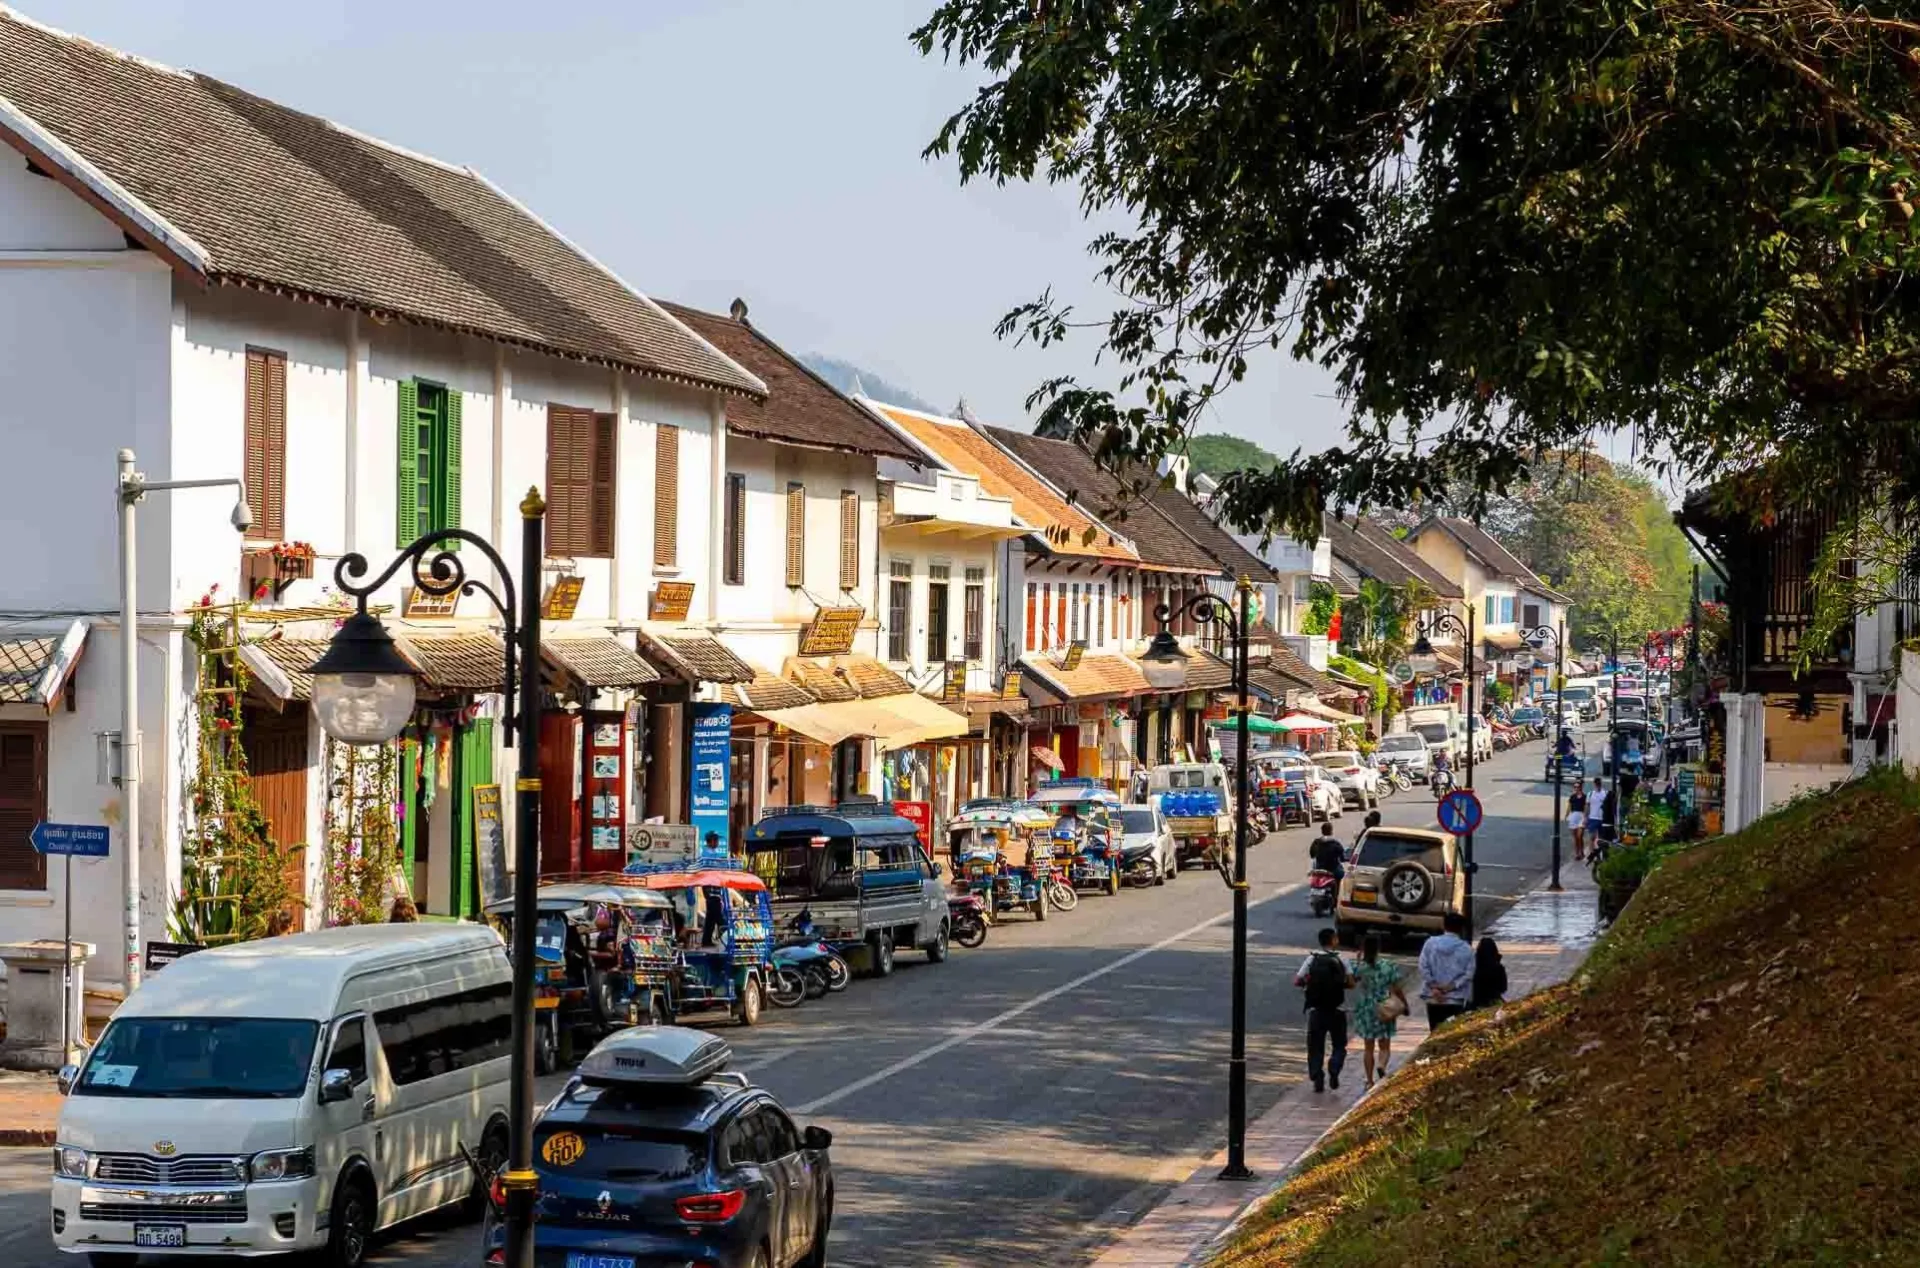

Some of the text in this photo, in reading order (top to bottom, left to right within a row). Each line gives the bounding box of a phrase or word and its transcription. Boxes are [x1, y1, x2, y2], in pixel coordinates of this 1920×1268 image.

[704, 718, 718, 726] HUB
[549, 1133, 578, 1151] LET'S
[576, 1210, 631, 1221] KADJAR
